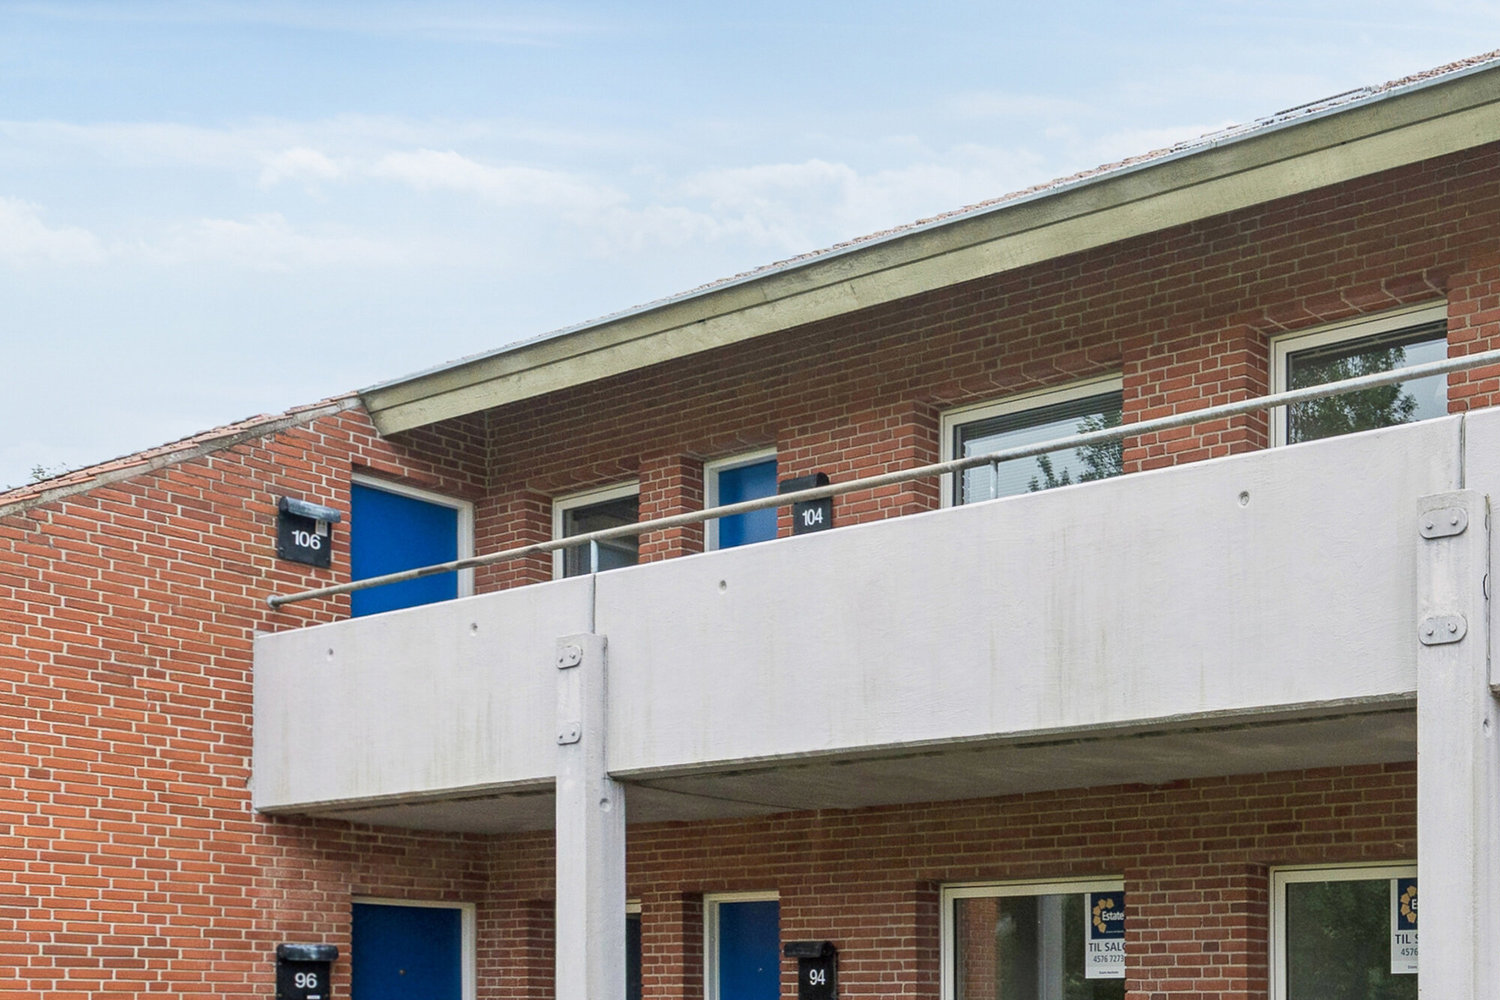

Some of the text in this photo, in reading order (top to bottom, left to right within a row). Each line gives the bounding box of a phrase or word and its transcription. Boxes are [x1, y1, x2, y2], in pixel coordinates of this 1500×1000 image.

[802, 507, 824, 526] 104
[291, 529, 321, 550] 106
[1395, 934, 1411, 945] TIL
[1088, 942, 1102, 952] TIL
[1400, 948, 1418, 957] 4576
[1093, 955, 1108, 963] 4576
[295, 972, 317, 988] 96
[809, 968, 826, 985] 94
